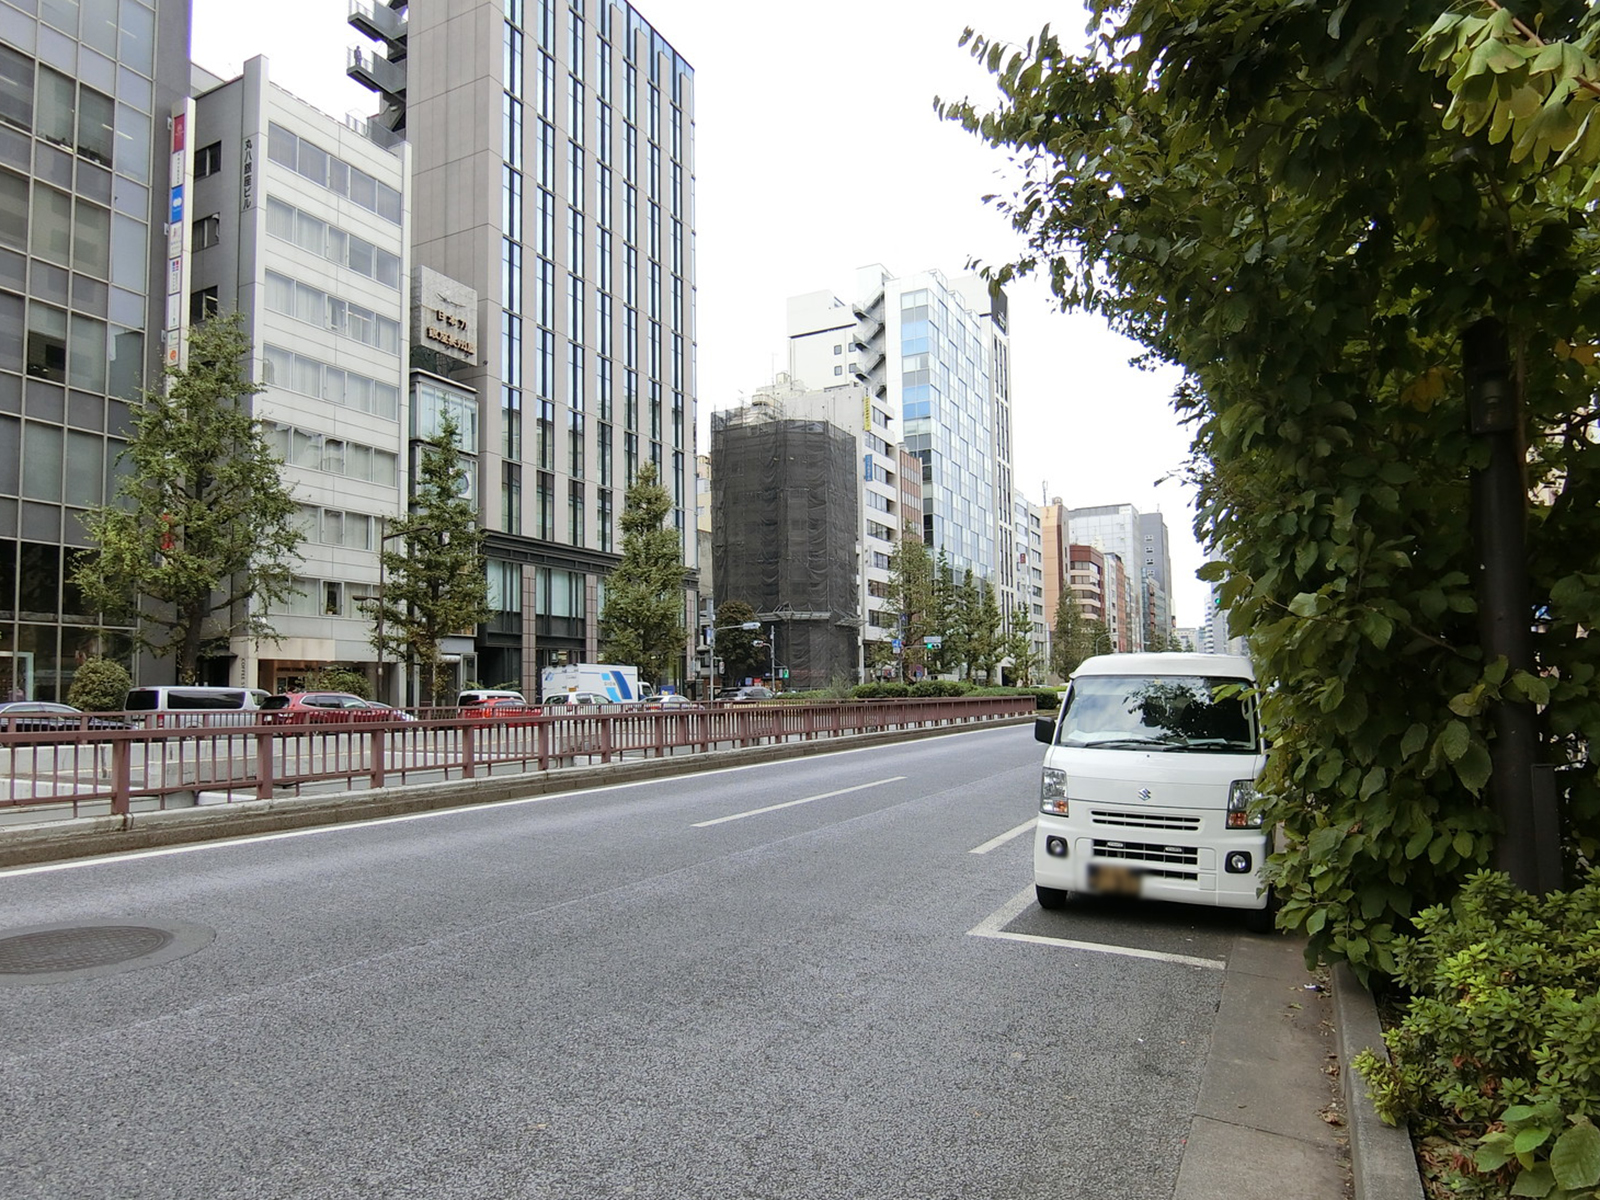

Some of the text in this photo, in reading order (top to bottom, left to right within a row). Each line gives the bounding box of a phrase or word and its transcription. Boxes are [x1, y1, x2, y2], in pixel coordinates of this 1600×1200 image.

[243, 139, 253, 210] 丸八銀座ビル
[437, 310, 467, 331] 日本刀
